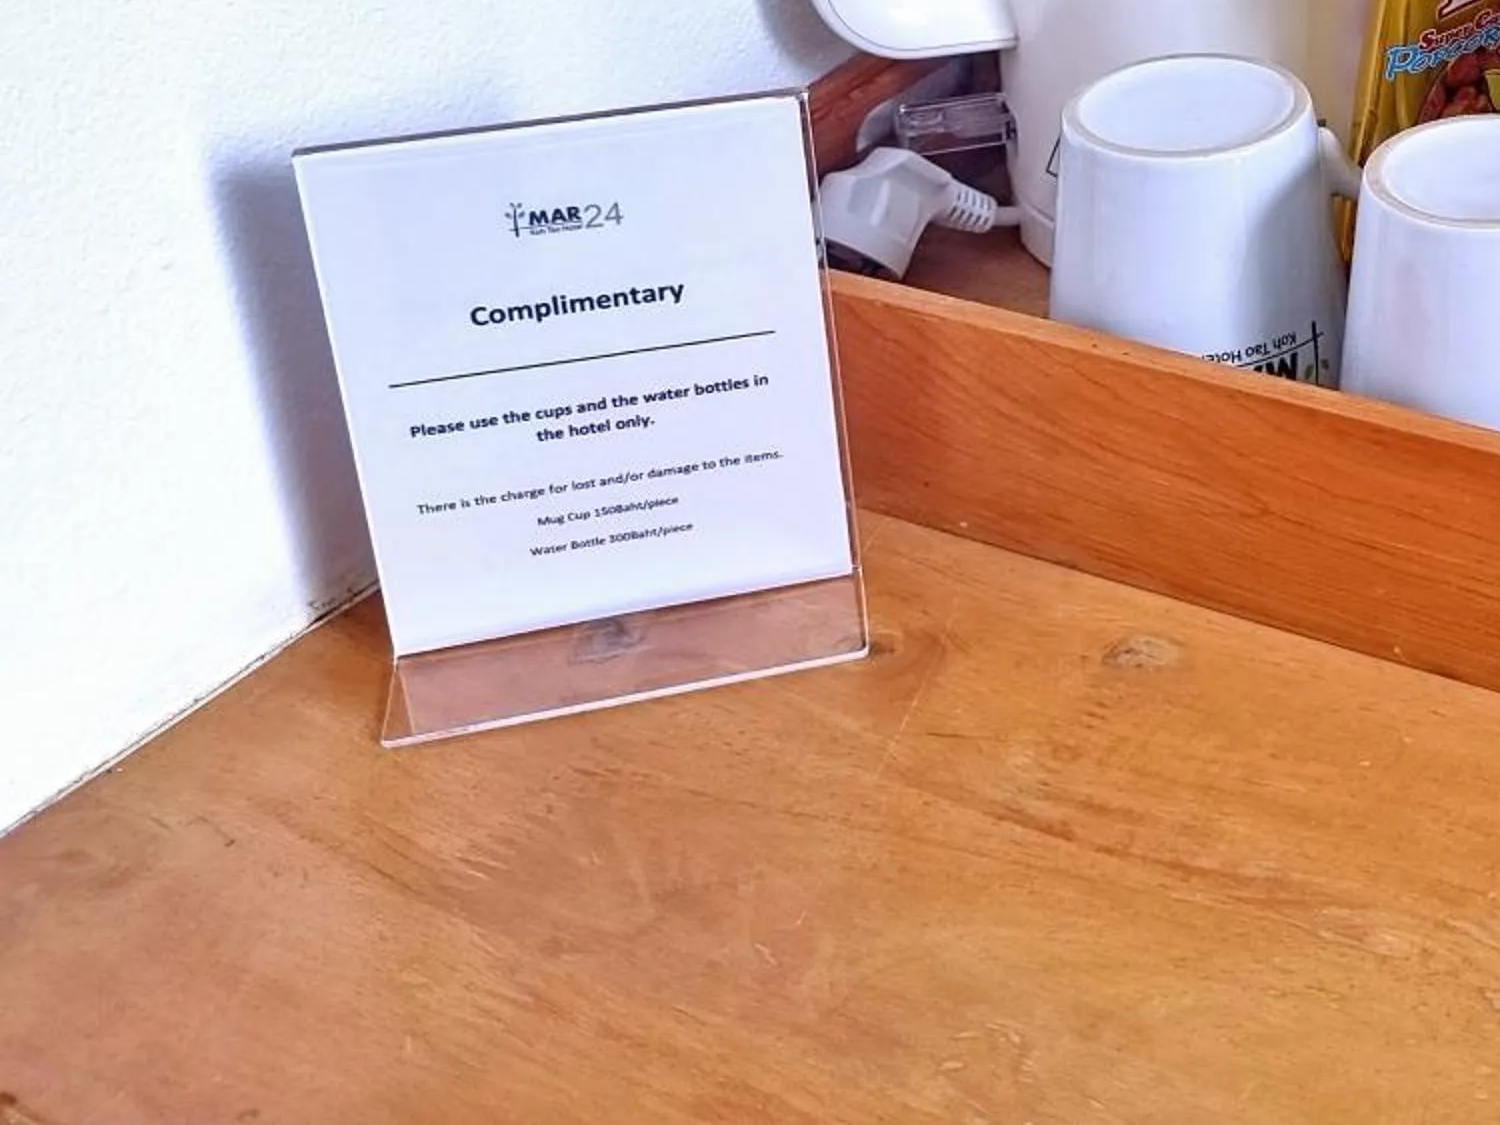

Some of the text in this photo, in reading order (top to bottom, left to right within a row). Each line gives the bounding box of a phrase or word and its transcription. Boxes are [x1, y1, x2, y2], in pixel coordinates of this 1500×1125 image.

[469, 283, 685, 327] Complimentary
[1245, 342, 1271, 358] Tao
[1272, 330, 1297, 349] Koh
[409, 374, 769, 438] Please use the cups and the water bottles in
[536, 414, 656, 442] the hotel only.
[416, 501, 457, 515] There
[460, 498, 471, 509] is
[474, 494, 497, 507] the
[500, 488, 546, 503] charge
[549, 483, 569, 495] for
[571, 479, 596, 492] lost
[599, 472, 644, 488] and/or
[647, 463, 700, 480] damage
[702, 459, 717, 471] to
[719, 455, 741, 468] the
[537, 515, 565, 526] Mug
[567, 510, 591, 523] Cup
[529, 543, 568, 557] Water
[570, 535, 607, 550] Bottle
